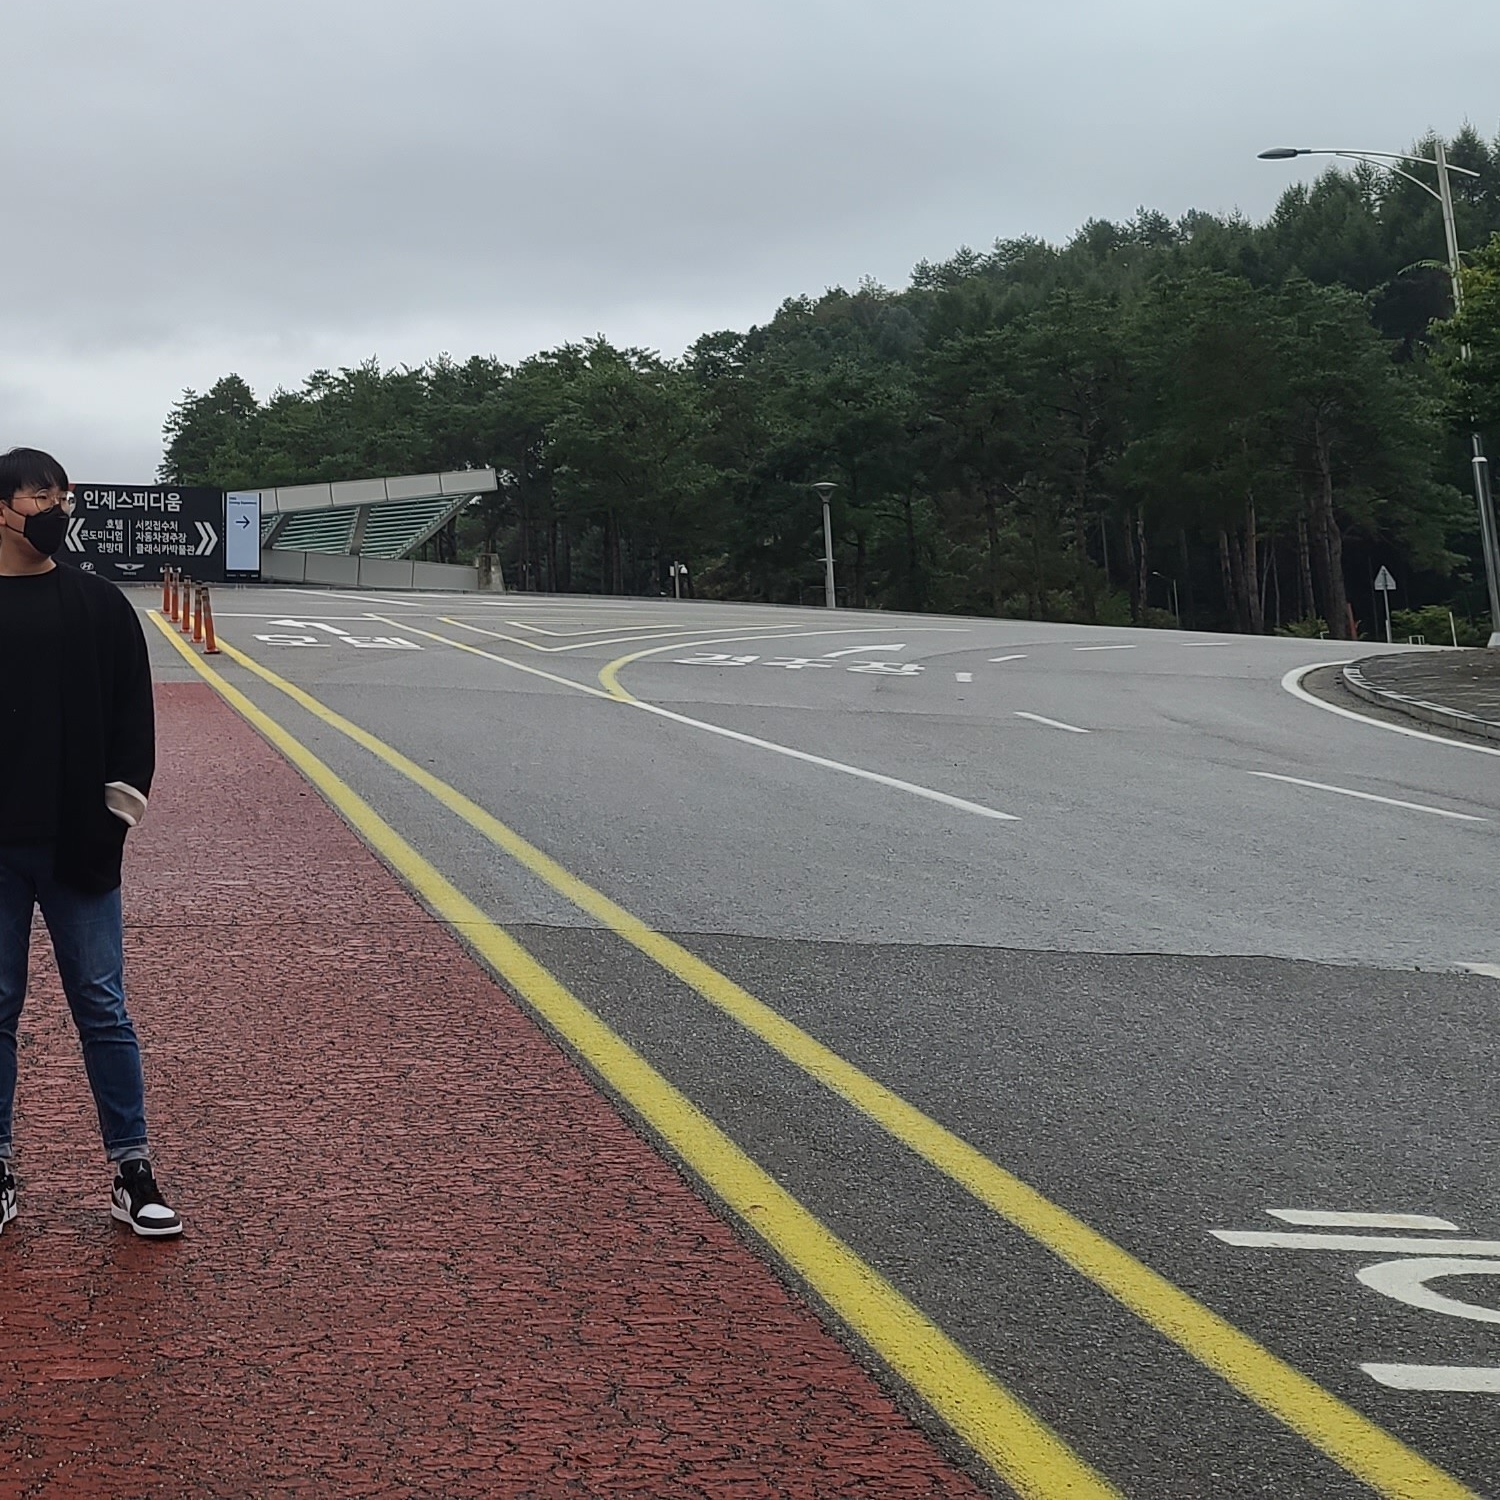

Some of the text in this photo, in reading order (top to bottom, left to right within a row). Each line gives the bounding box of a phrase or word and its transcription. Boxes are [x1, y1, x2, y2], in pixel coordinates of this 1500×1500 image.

[83, 490, 182, 512] 인제스피디움
[105, 519, 123, 530] 호텔
[80, 530, 123, 541] 콘도미니엄
[135, 531, 187, 543] 자동차경주장
[97, 542, 123, 554] 전망대
[135, 543, 195, 556] 클래식카박물관
